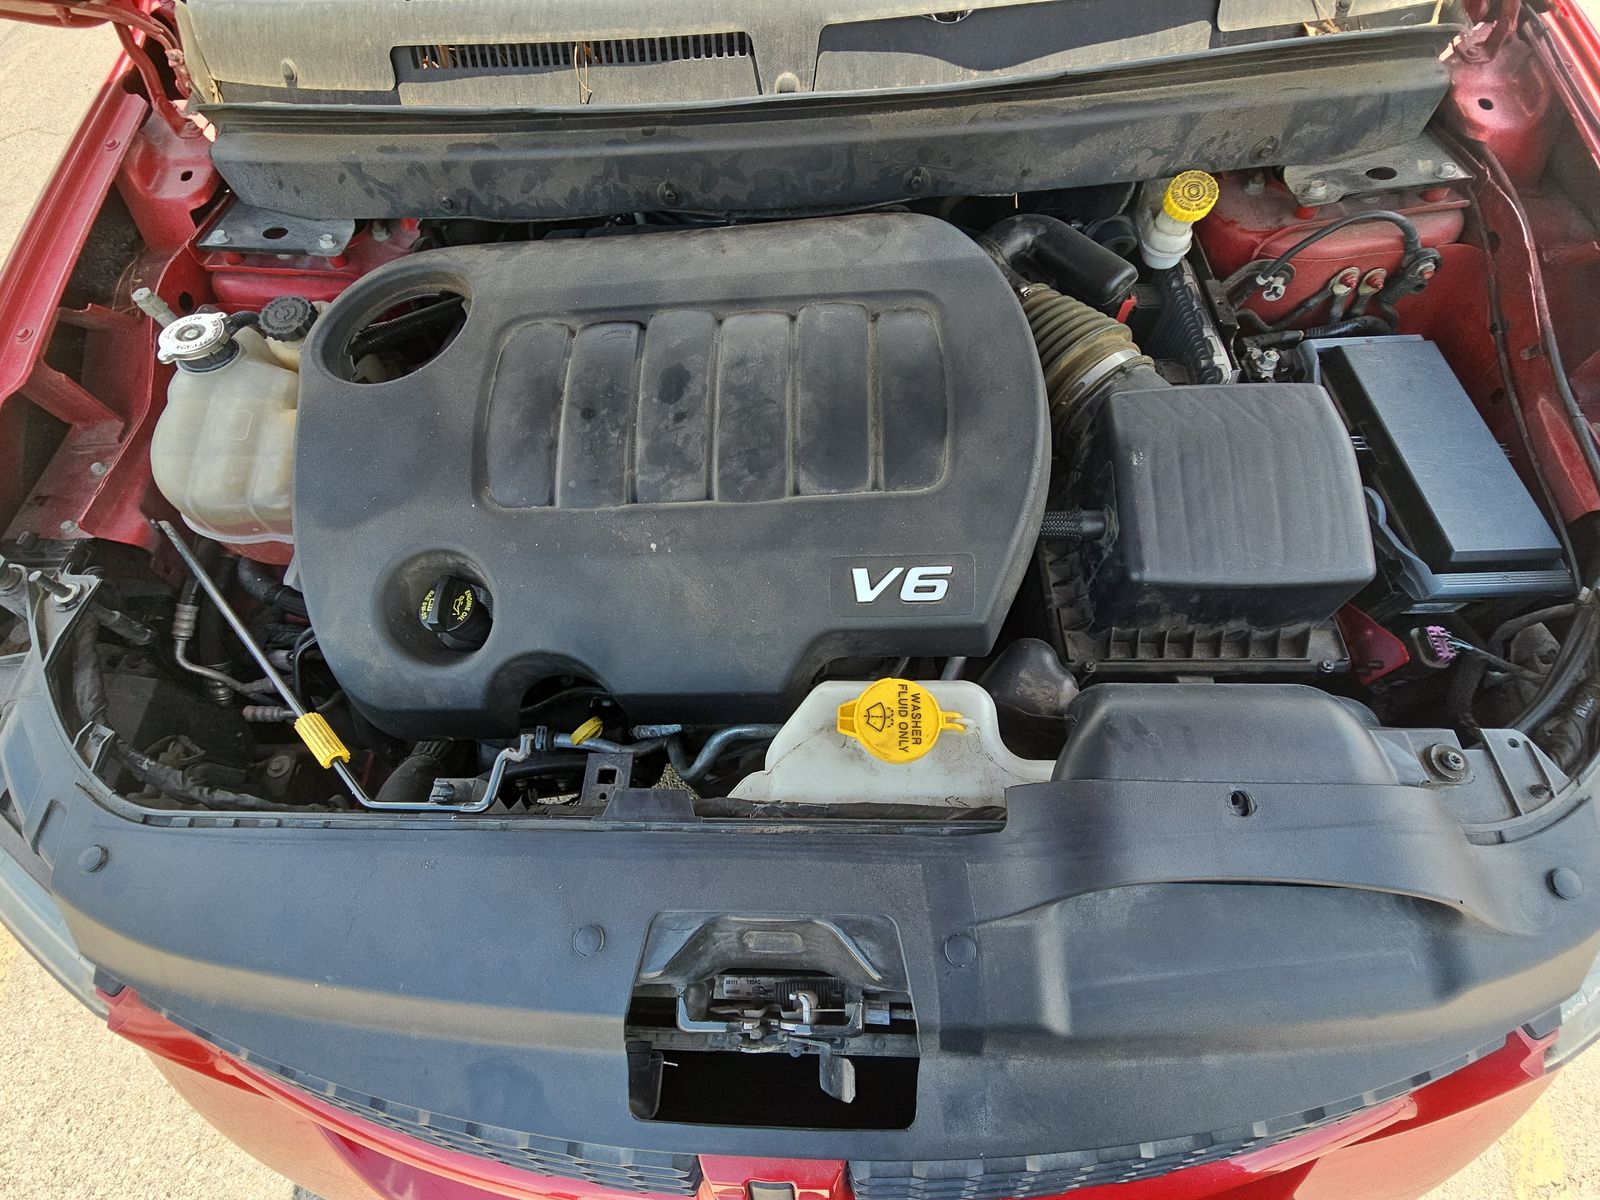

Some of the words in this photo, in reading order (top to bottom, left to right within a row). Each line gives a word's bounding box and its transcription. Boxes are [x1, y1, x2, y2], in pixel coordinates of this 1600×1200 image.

[464, 589, 473, 612] ENGINE
[852, 566, 953, 602] V6
[457, 611, 468, 621] OIL
[898, 683, 908, 718] FLUID
[911, 692, 922, 745] WASHER
[898, 721, 909, 753] ONLY
